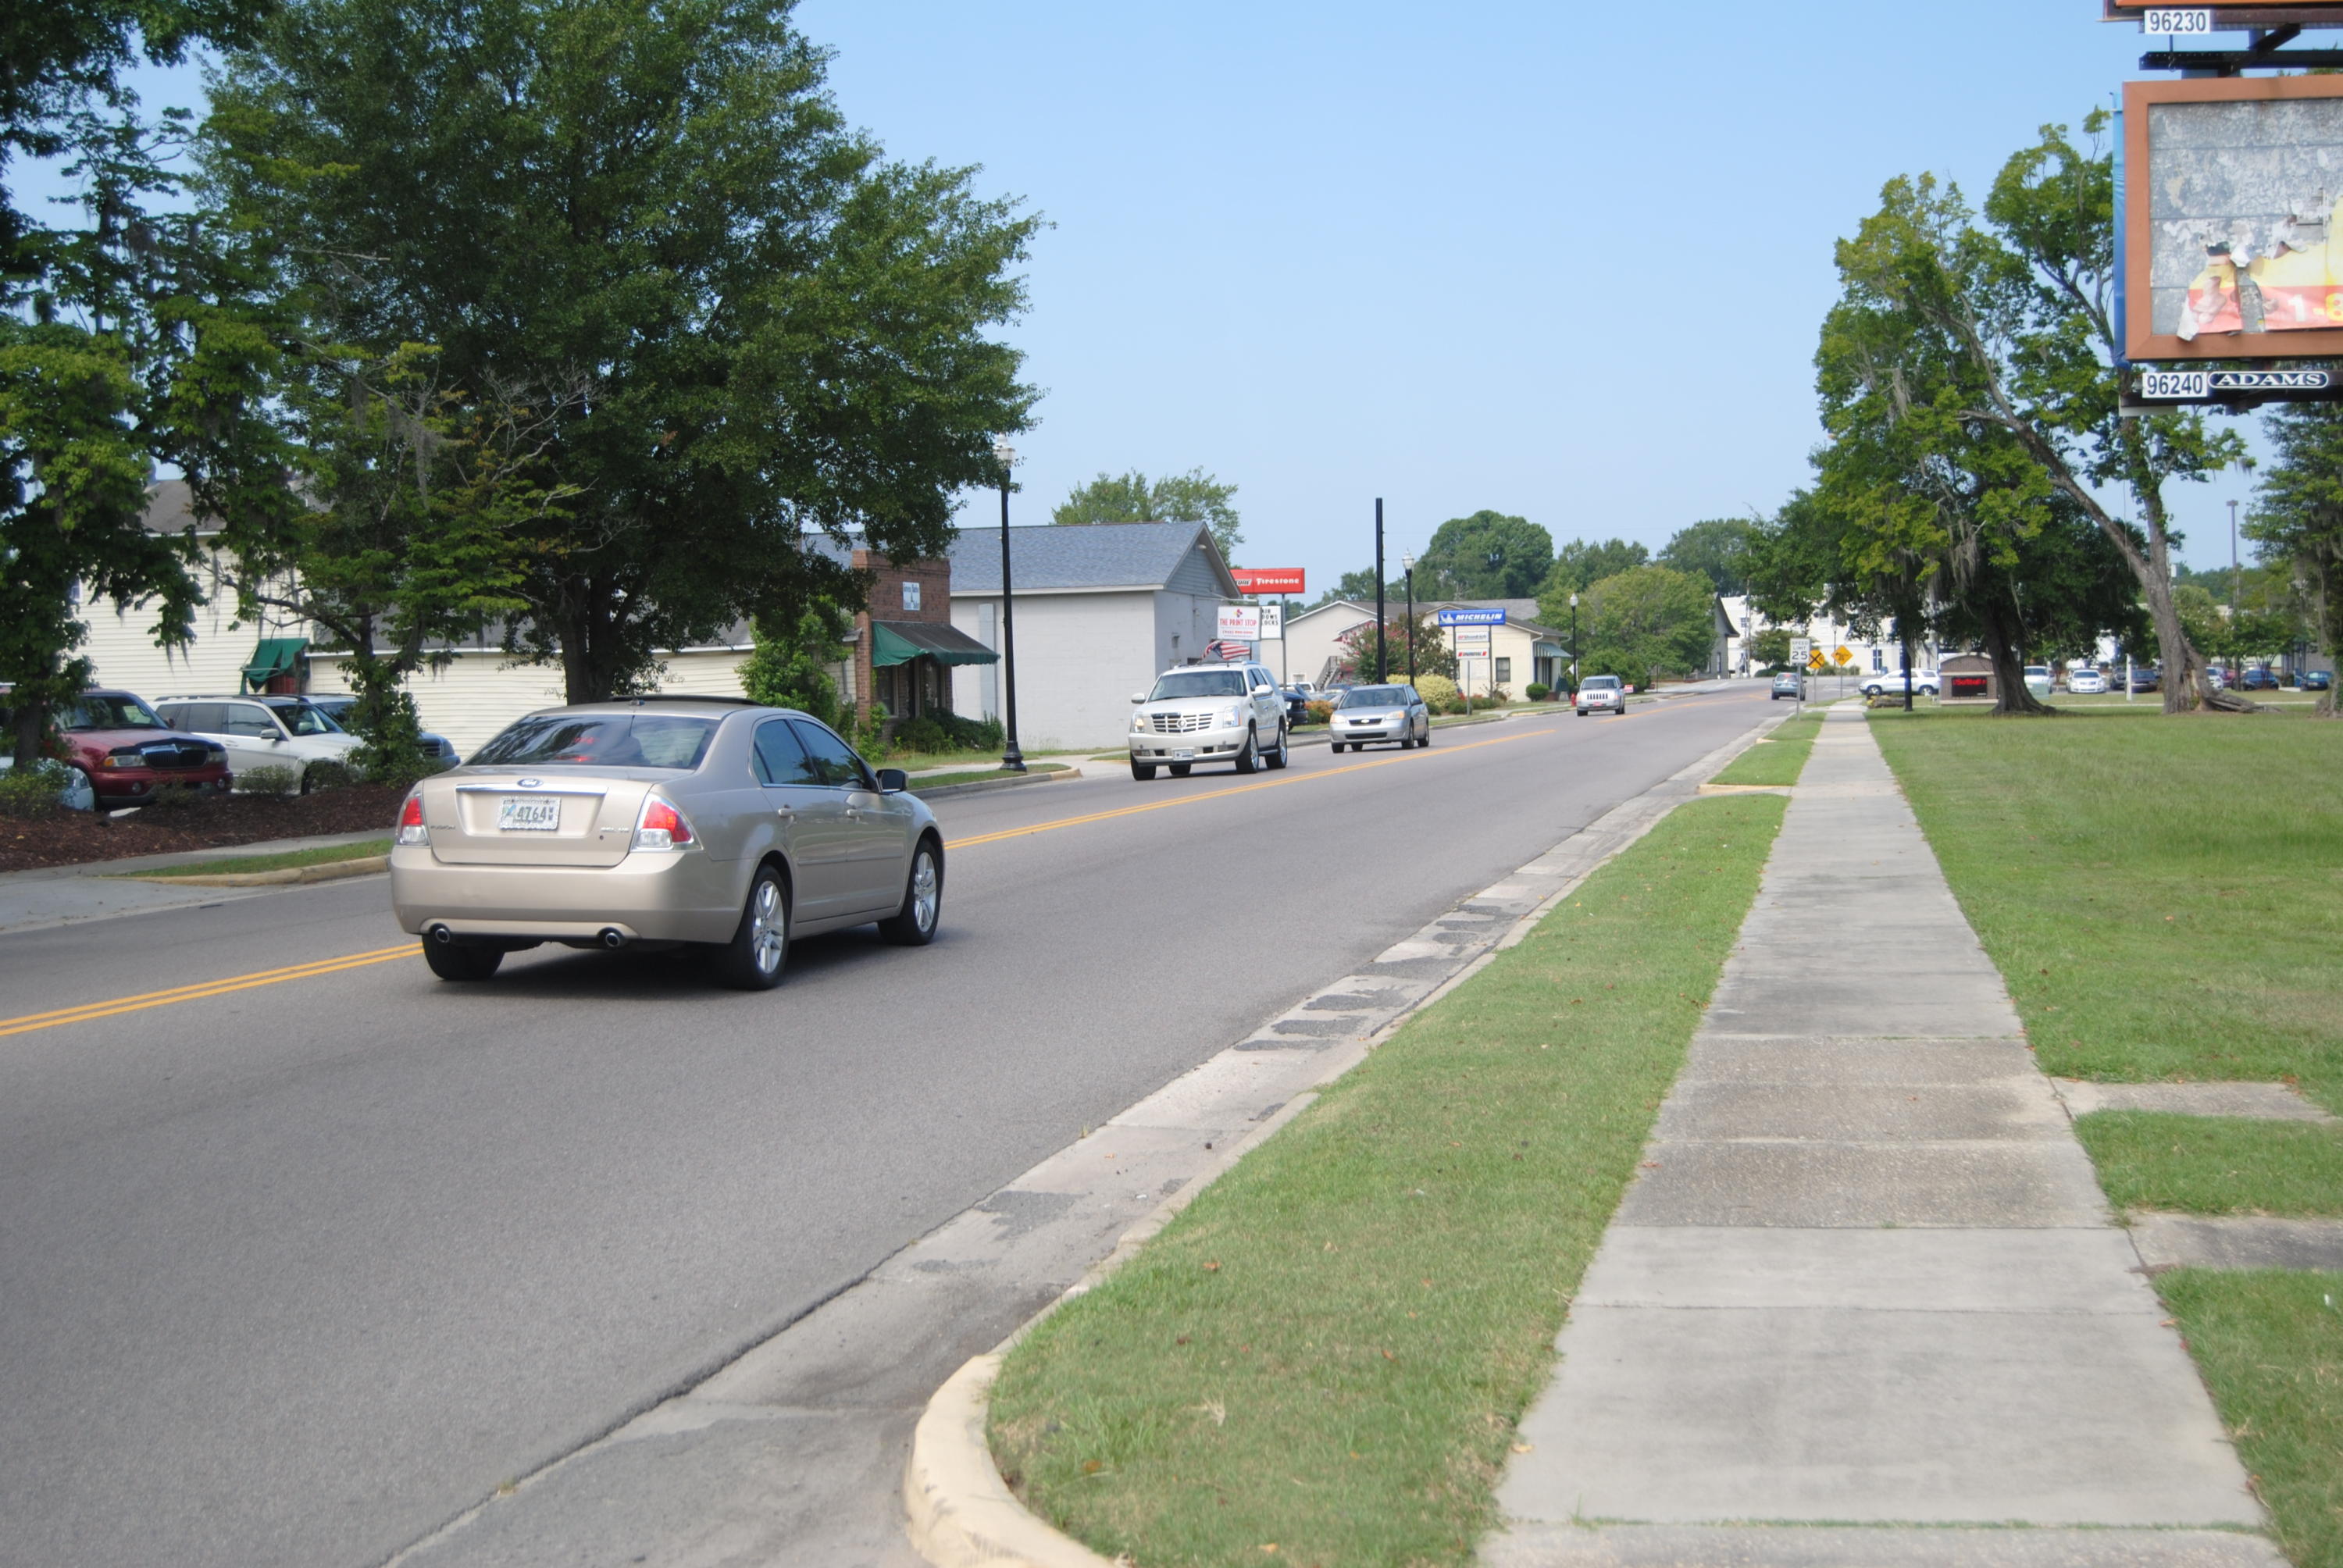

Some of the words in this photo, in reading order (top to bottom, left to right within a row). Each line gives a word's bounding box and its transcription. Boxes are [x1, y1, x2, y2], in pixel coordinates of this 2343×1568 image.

[2149, 12, 2206, 32] 96230
[2147, 374, 2202, 394] 96240
[2216, 373, 2320, 386] ADAMS
[1792, 651, 1807, 660] 25
[517, 807, 547, 821] 4764
